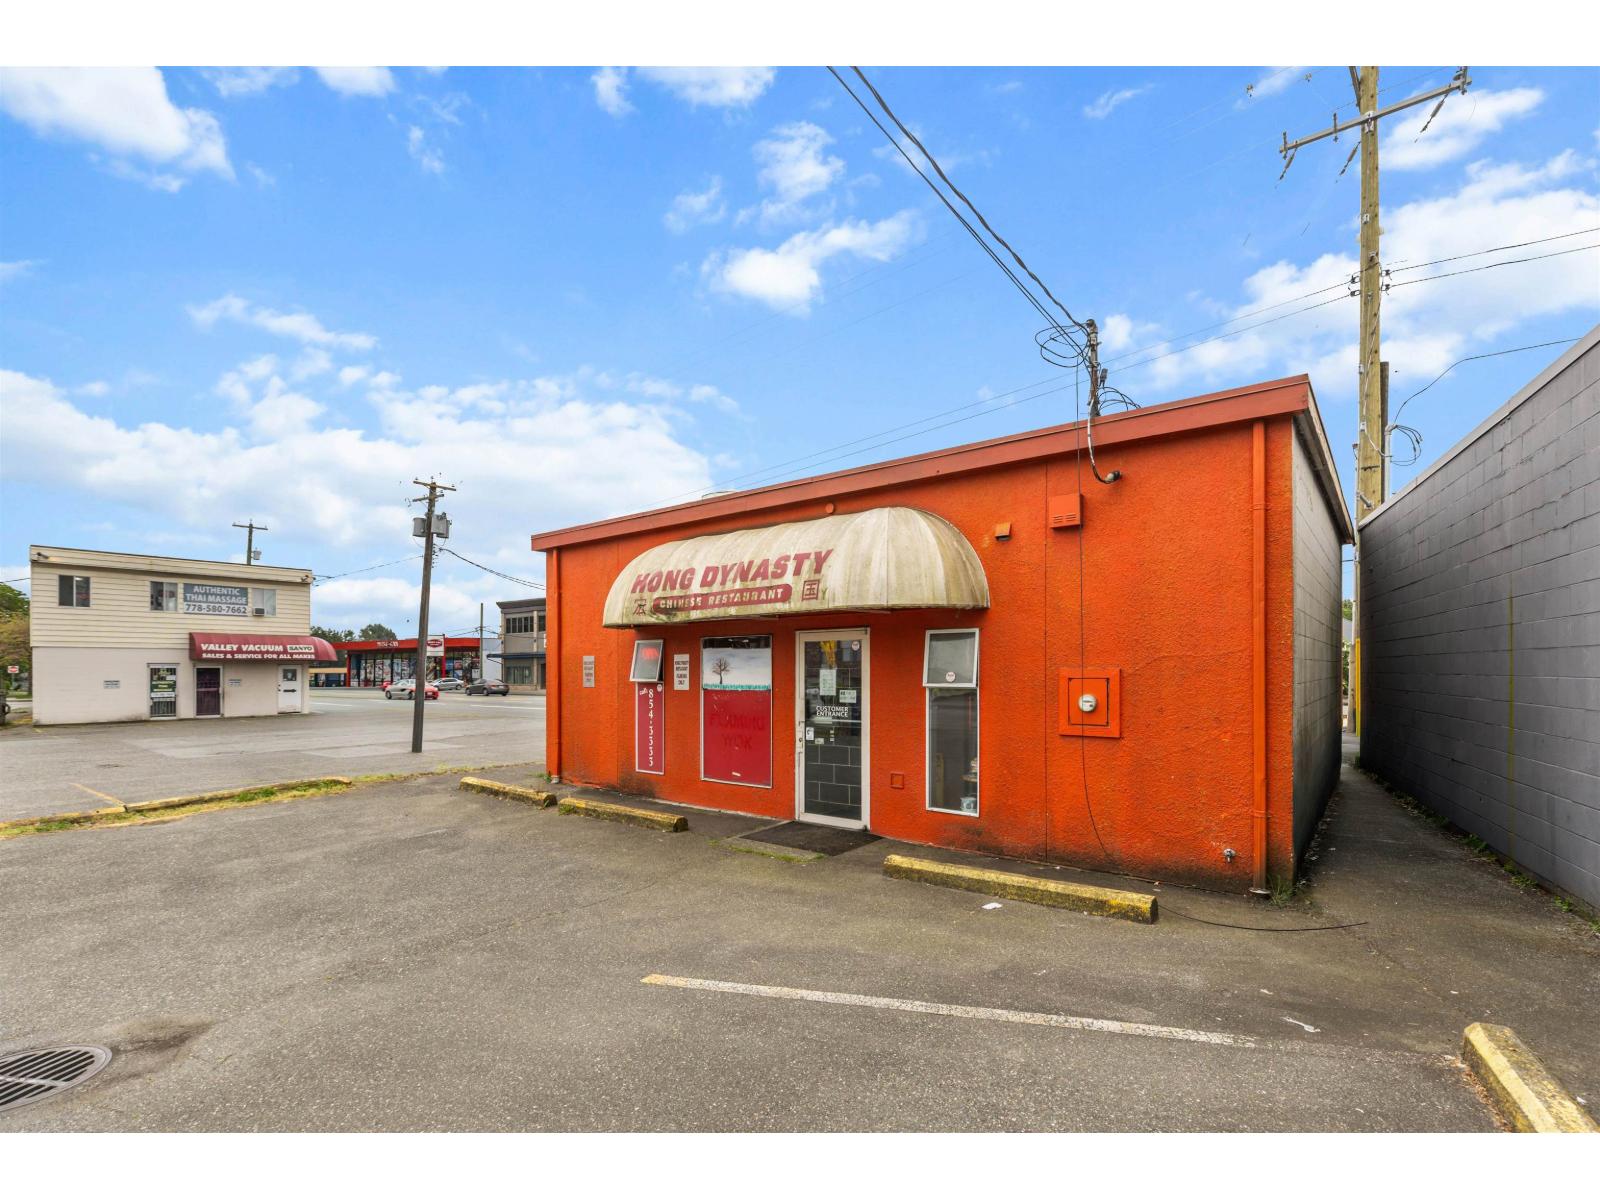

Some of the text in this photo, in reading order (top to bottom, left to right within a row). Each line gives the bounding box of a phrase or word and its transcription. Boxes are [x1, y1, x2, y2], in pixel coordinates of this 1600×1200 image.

[630, 549, 834, 593] HONG DYNASTY
[193, 585, 240, 596] AUTHENTIC
[185, 593, 247, 605] THAI MASSAGE
[659, 588, 783, 609] CHINESE RESTAURANT
[185, 603, 247, 615] 778-580-7662
[201, 643, 284, 653] VALLEY VACUUM
[234, 652, 263, 660] SERVICE
[815, 704, 849, 713] CUSTOMER
